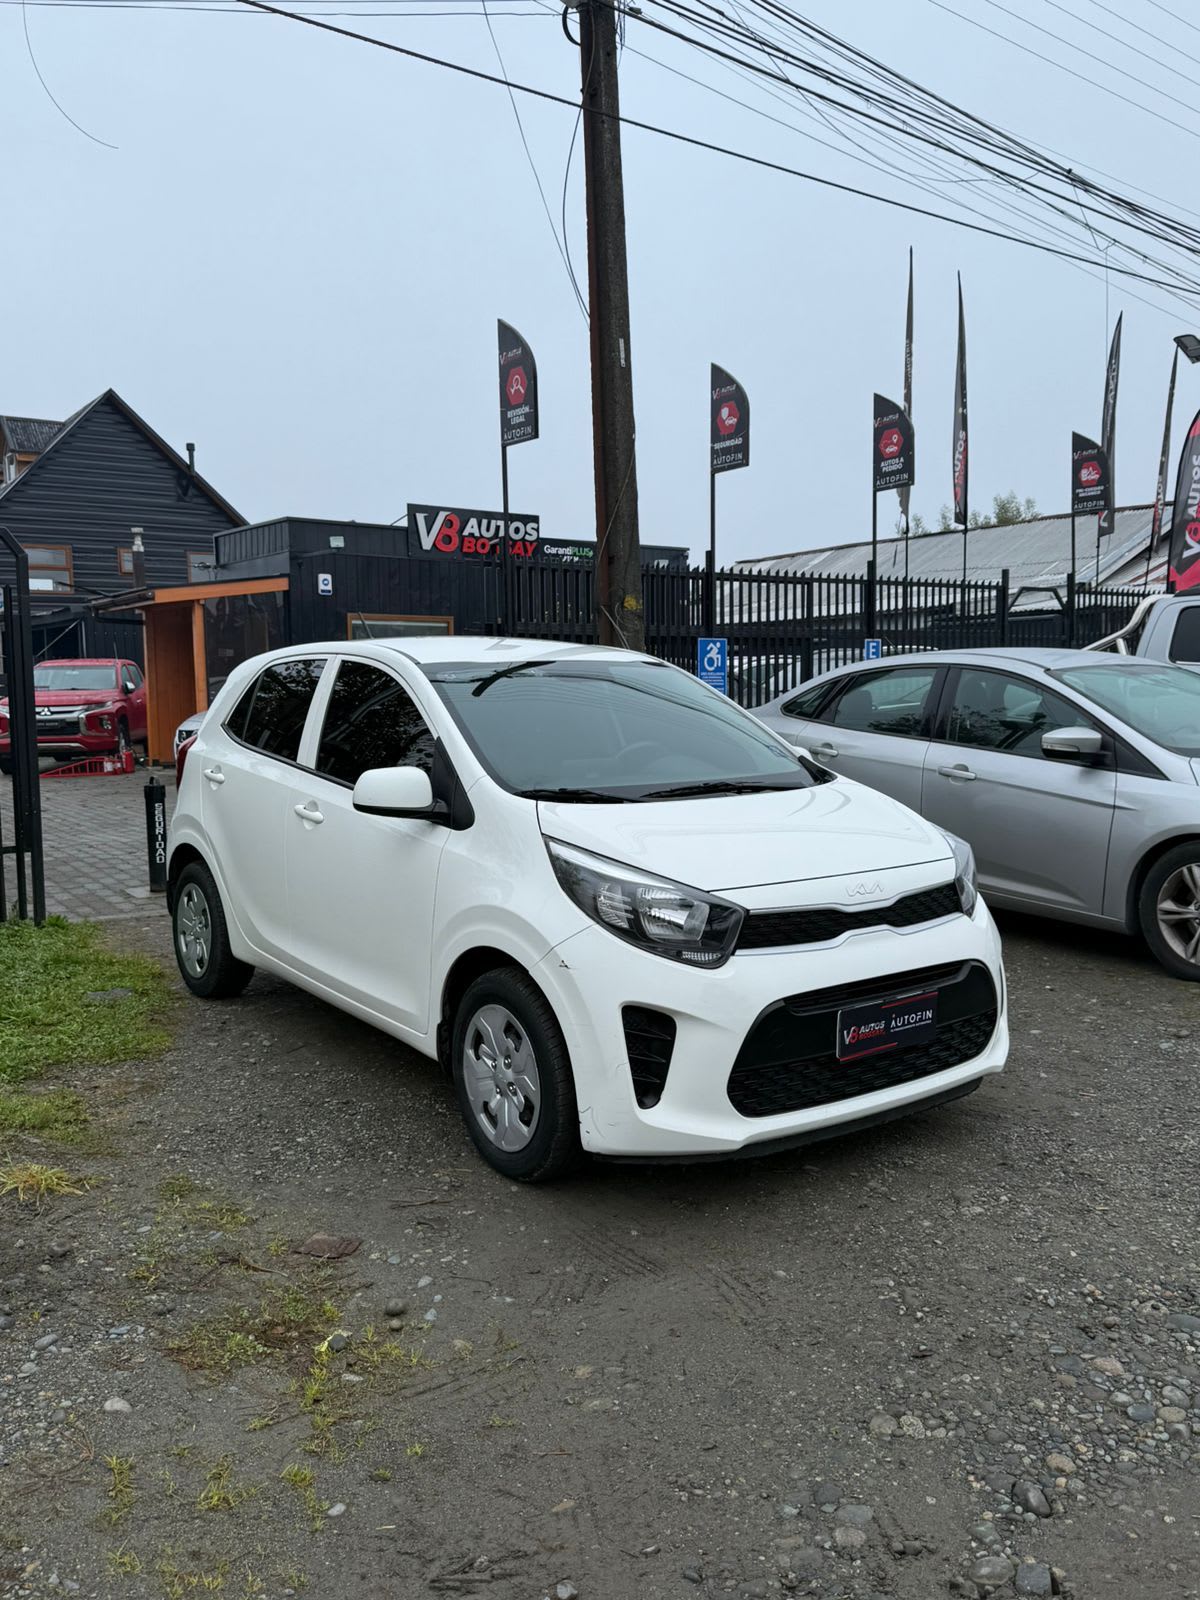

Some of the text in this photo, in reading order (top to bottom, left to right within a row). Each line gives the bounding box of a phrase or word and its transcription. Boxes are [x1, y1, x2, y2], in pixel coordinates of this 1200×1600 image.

[510, 415, 526, 424] LEGAL
[503, 425, 532, 440] AUTOFIN
[713, 452, 743, 465] AUTOFIN
[880, 459, 900, 468] AUTOS
[882, 464, 903, 473] PEDIDO
[876, 473, 908, 486] AUTOFIN
[1074, 501, 1104, 510] AUTOFIN
[415, 511, 538, 552] V8 AUTOS
[462, 537, 537, 557] BOAY
[869, 643, 876, 658] E
[155, 803, 165, 863] SEGURIDAD
[859, 1021, 885, 1034] AUTOS
[890, 1009, 933, 1028] AUTOFIN
